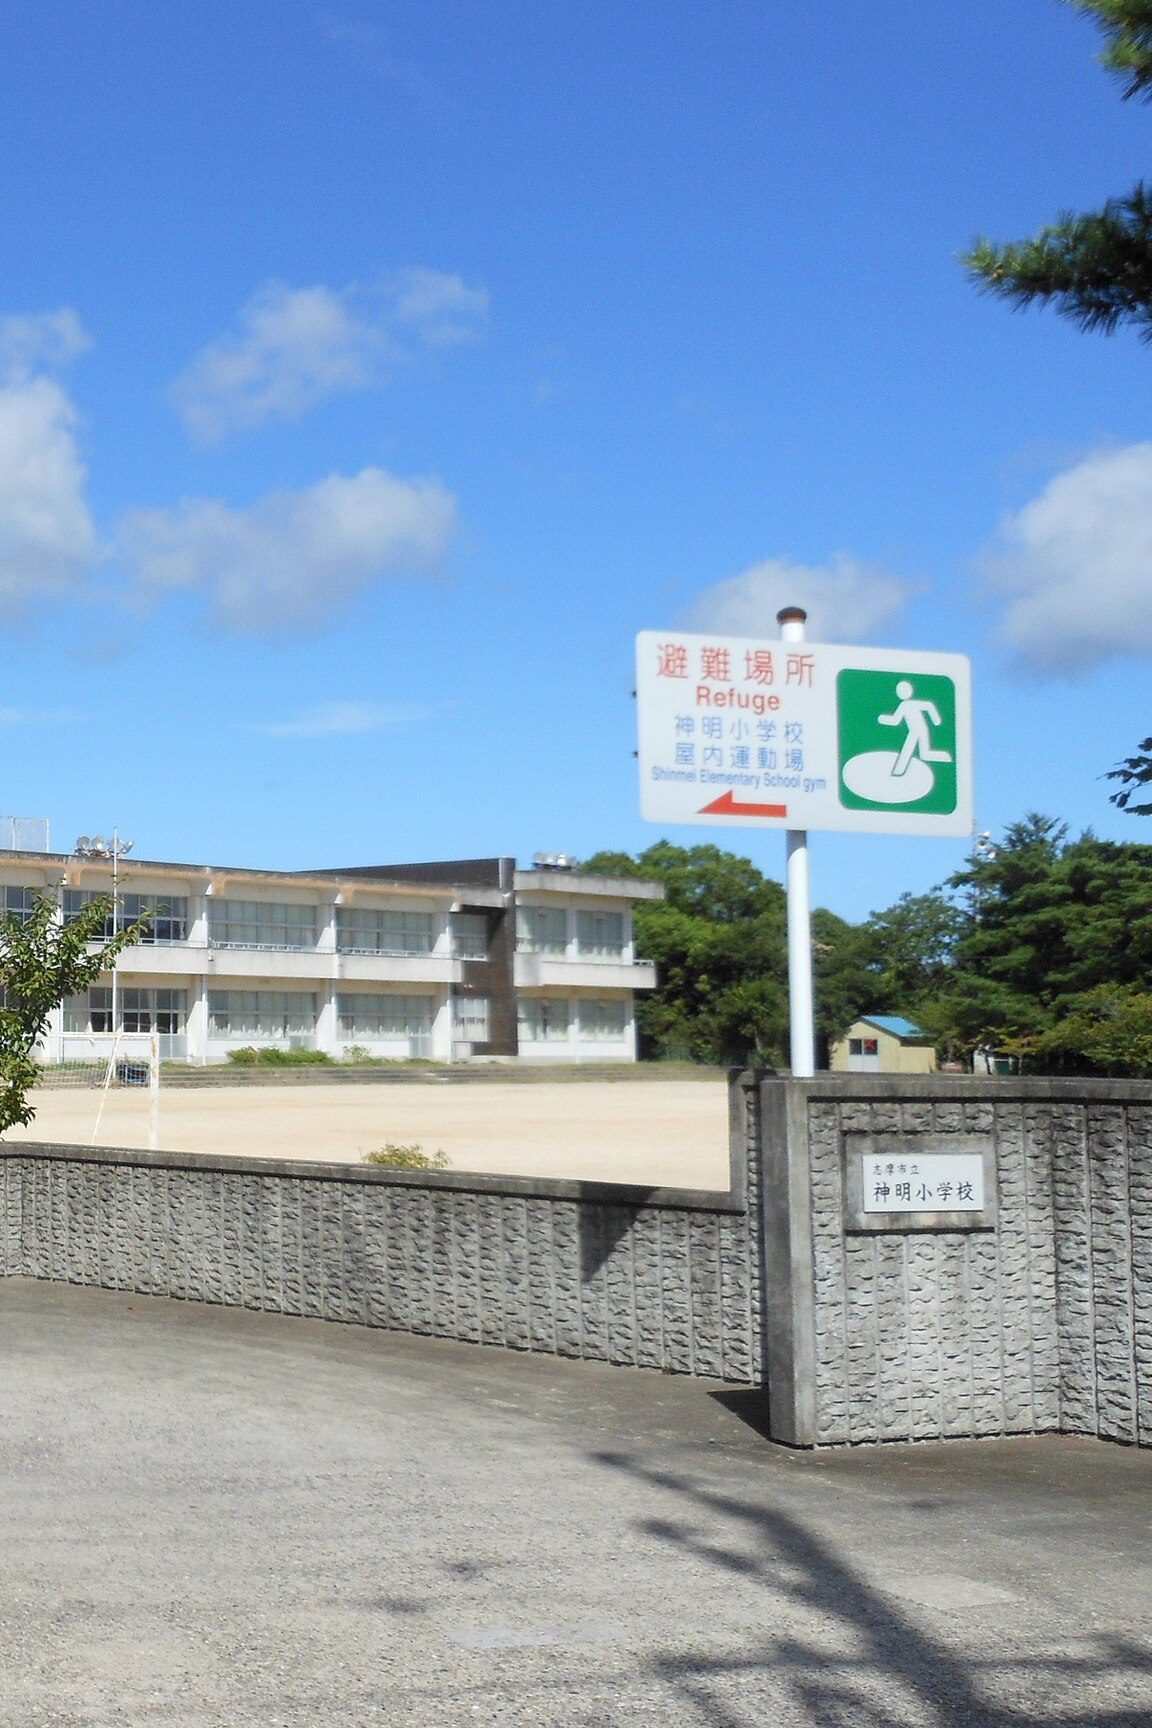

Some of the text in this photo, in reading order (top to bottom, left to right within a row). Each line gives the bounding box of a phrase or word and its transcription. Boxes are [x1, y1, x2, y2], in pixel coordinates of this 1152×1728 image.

[656, 643, 815, 688] 避難場所
[696, 686, 780, 715] Refuge
[674, 715, 804, 744] 神明小学校
[674, 742, 804, 772] 屋内運動場
[652, 766, 826, 793] Shinmei Elementary School gym
[872, 1163, 921, 1176] 志摩市立
[873, 1181, 975, 1204] 神明小学校
